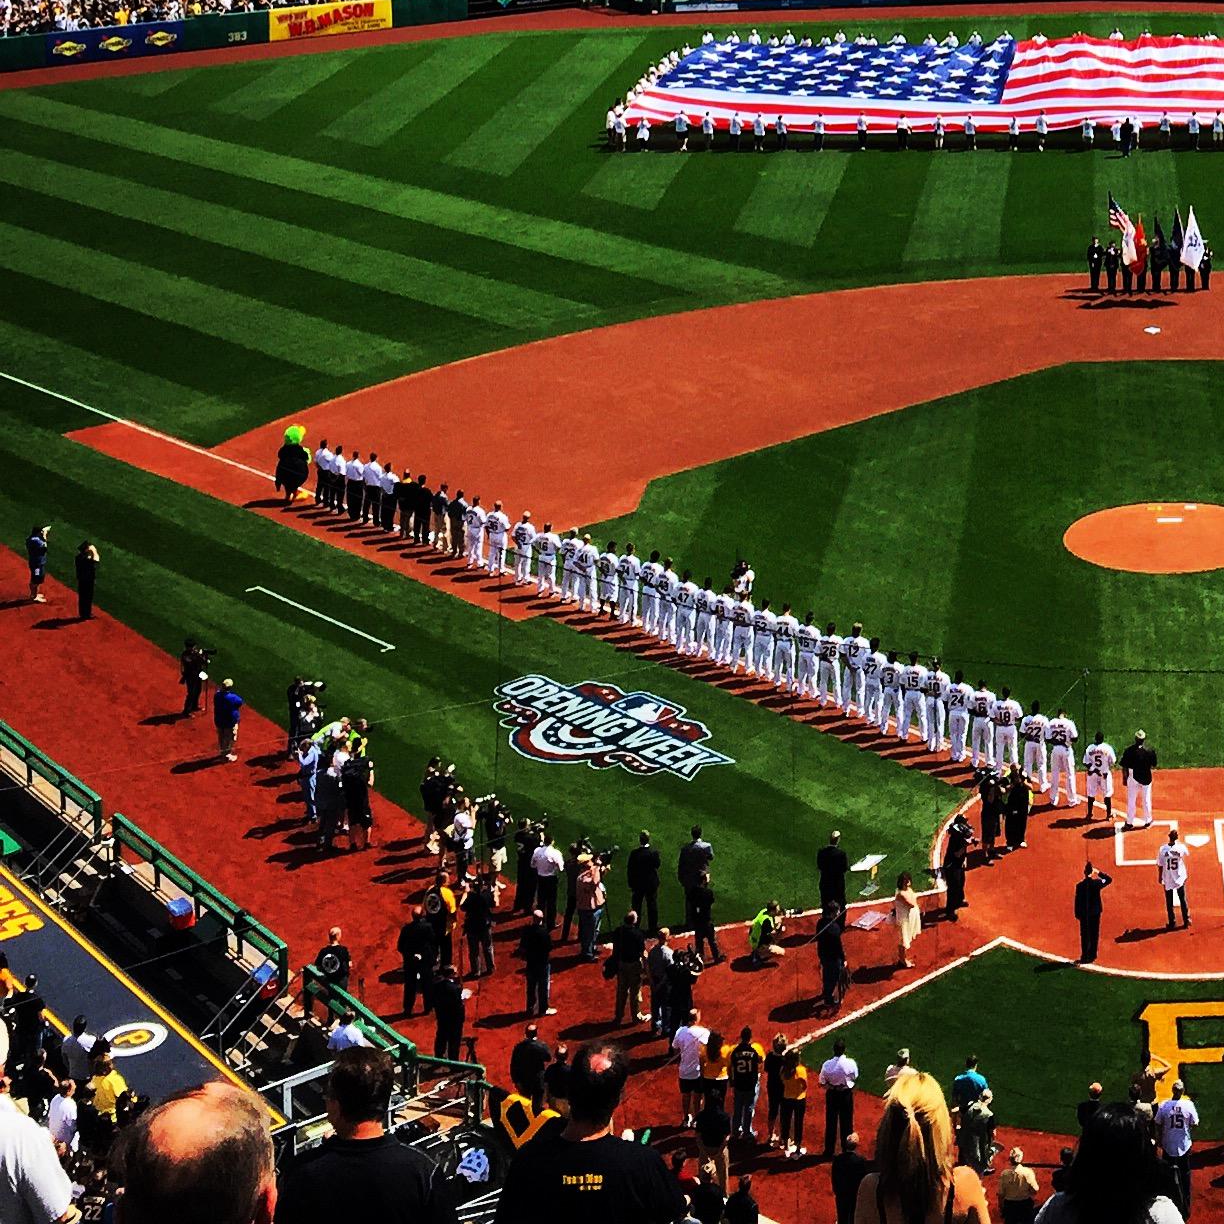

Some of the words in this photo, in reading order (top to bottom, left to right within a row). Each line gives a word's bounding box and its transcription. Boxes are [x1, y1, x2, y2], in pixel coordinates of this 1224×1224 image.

[822, 645, 837, 657] 26
[886, 672, 894, 684] 3
[907, 675, 919, 688] 15
[951, 694, 965, 707] 24
[1000, 712, 1011, 724] 18
[501, 676, 638, 738] OPENING
[618, 725, 722, 776] WEEK
[1094, 755, 1103, 768] 5
[1166, 857, 1179, 871] 15
[112, 1028, 152, 1047] P
[736, 1059, 752, 1073] 21
[1169, 1114, 1185, 1130] 15
[84, 1204, 102, 1221] 22
